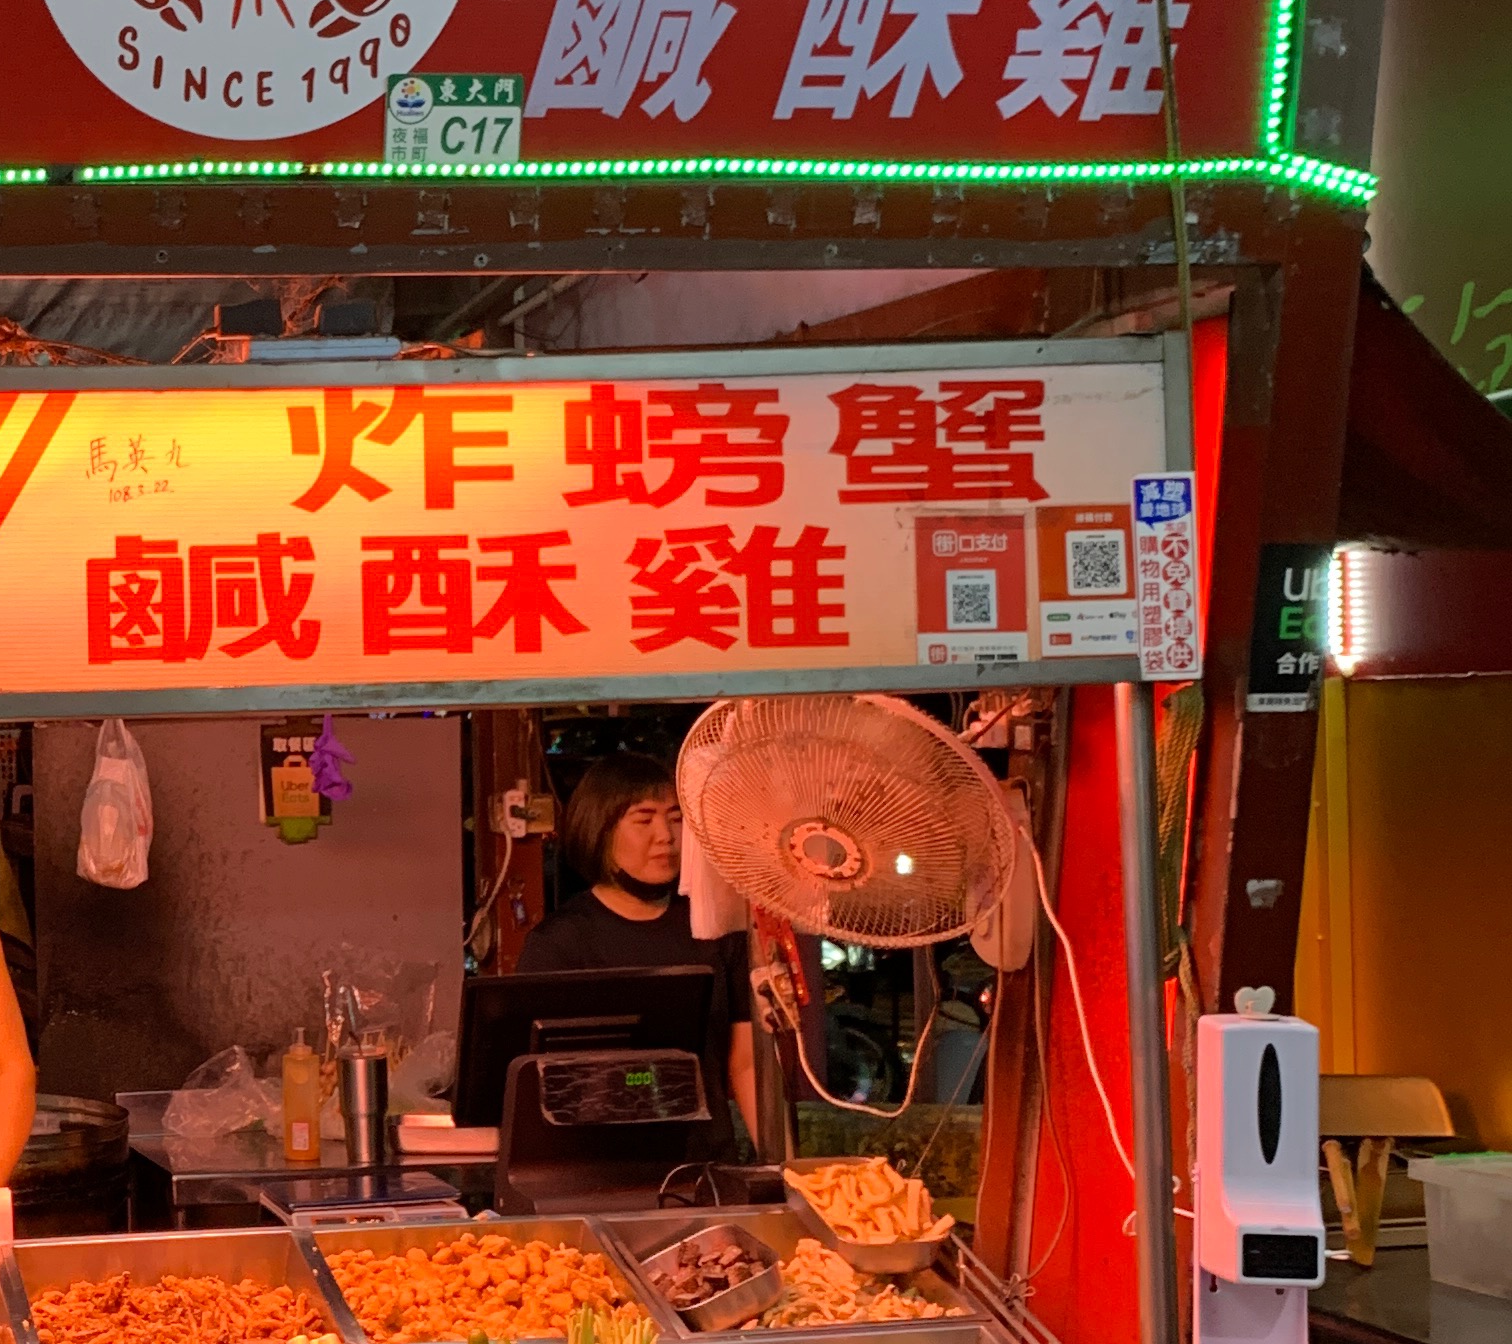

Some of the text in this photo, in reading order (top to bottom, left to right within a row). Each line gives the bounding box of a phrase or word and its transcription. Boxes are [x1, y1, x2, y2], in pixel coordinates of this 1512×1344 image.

[118, 26, 274, 108] SINCE
[439, 78, 515, 103] 東大門
[440, 116, 515, 155] C17
[287, 380, 1051, 511] 炸螃蟹
[932, 529, 1008, 557] 街口支付
[86, 523, 850, 665] 鹹酥雞
[1139, 535, 1165, 672] 購物用塑膠袋
[281, 780, 309, 791] Uber
